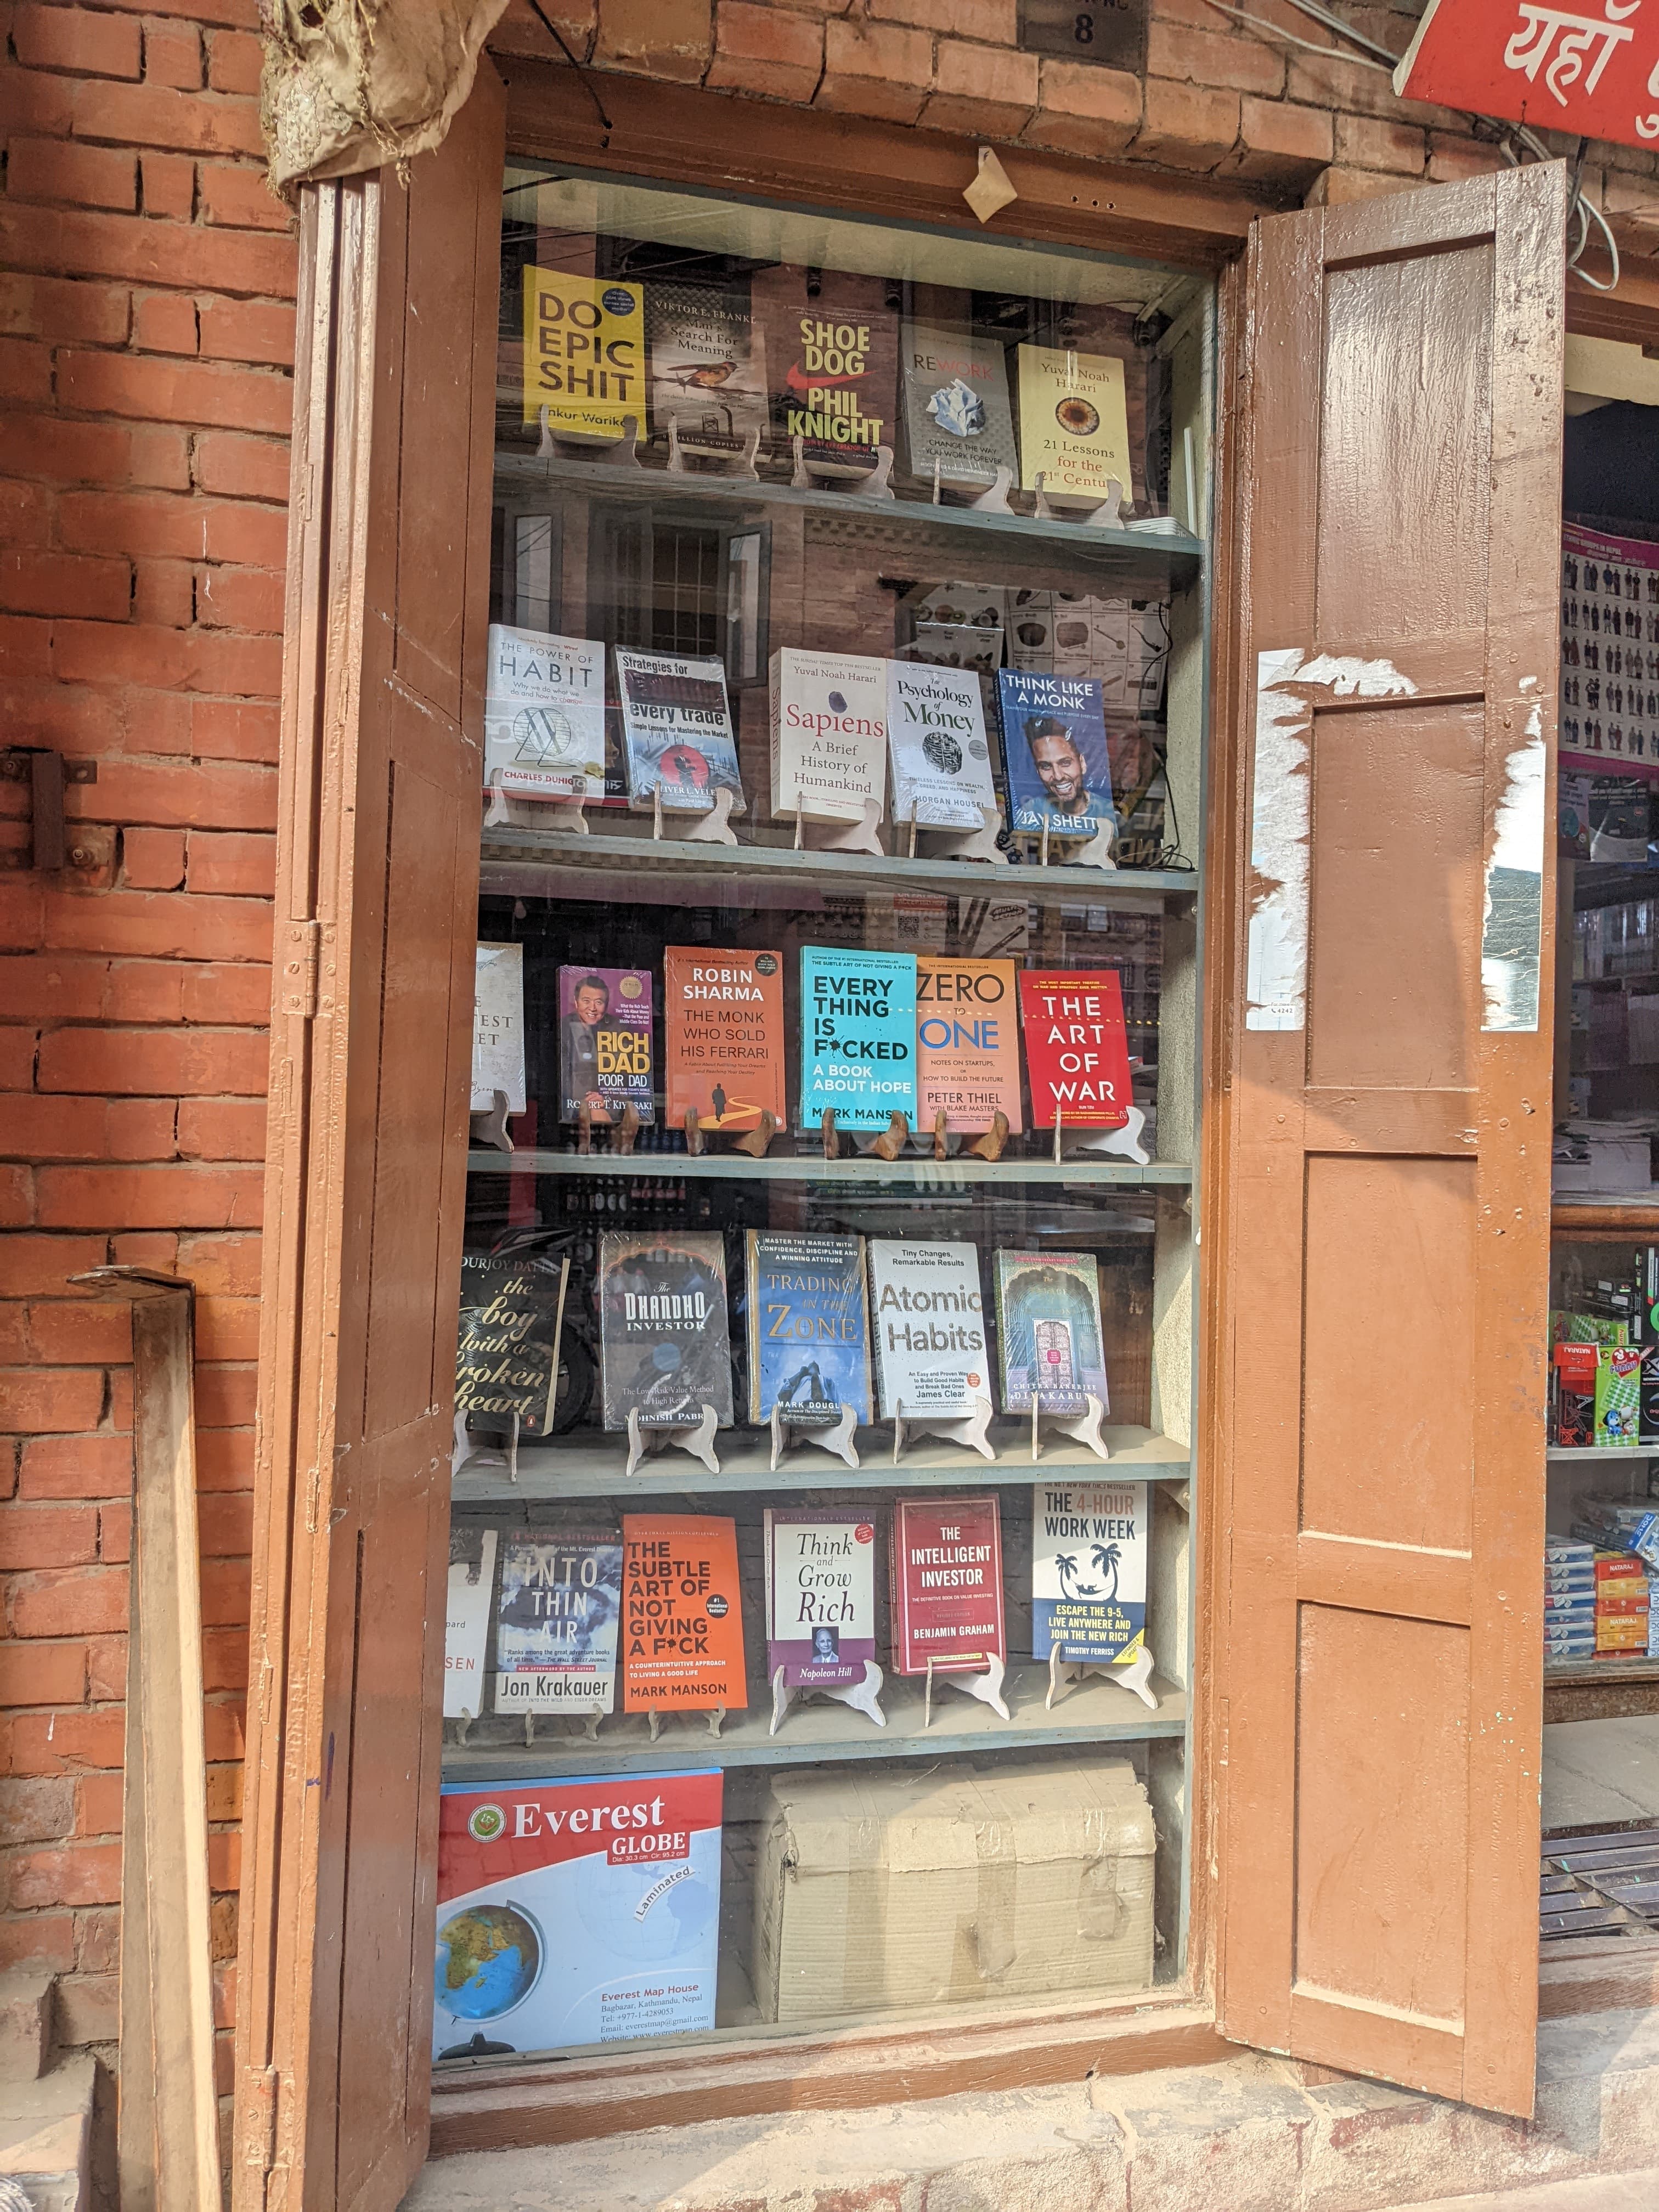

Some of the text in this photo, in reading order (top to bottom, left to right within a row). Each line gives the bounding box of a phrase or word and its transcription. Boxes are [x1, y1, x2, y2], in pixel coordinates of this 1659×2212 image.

[1075, 14, 1093, 44] 8
[539, 291, 602, 329] DO
[670, 326, 738, 346] Search For
[800, 319, 870, 351] SHOE
[539, 326, 635, 368] EPIC
[678, 339, 733, 359] Meaning
[806, 346, 865, 375] DOG
[913, 354, 995, 381] REWORK
[538, 360, 634, 402] SHIT
[808, 387, 862, 417] PHIL
[788, 410, 883, 445] KNIGHT
[1043, 439, 1115, 459] 21 Lessons
[1058, 456, 1102, 472] for the
[501, 642, 522, 653] THE
[530, 647, 571, 662] POWER
[578, 655, 593, 663] OF
[500, 655, 592, 688] HABIT
[623, 656, 688, 675] Strategies for
[794, 666, 877, 683] Yuval Noah Harari
[896, 680, 973, 708] Psychology
[1006, 675, 1093, 697] THINK LIKE
[1018, 691, 1085, 710] A MONK
[630, 703, 724, 726] every trade
[787, 704, 883, 737] Sapiens
[902, 701, 975, 737] Money
[812, 741, 859, 756] A Brief
[801, 755, 867, 774] History of
[794, 772, 872, 793] Humankind
[693, 968, 753, 984] ROBIN
[684, 985, 764, 1002] SHARMA
[814, 976, 893, 997] EVERY
[916, 973, 1005, 1003] ZERO
[814, 997, 890, 1017] THING
[1042, 997, 1101, 1016] THE
[684, 1010, 764, 1024] THE MONK
[815, 1018, 835, 1036] IS
[597, 1031, 649, 1053] RICH
[684, 1028, 765, 1041] WHO SOLD
[919, 1019, 999, 1049] ONE
[1048, 1025, 1104, 1045] ART
[681, 1046, 769, 1059] HIS FERRARI
[598, 1052, 650, 1074] DAD
[813, 1064, 872, 1077] A BOOK
[1059, 1053, 1099, 1073] OF
[598, 1074, 647, 1087] POOR DAD
[813, 1081, 911, 1093] ABOUT HOPE
[928, 1093, 1001, 1103] PETER THIEL
[1049, 1081, 1115, 1102] WAR
[902, 1249, 952, 1259] Tiny Changes,
[503, 1277, 533, 1295] the
[767, 1274, 853, 1293] TRADING
[624, 1291, 706, 1321] DHANDHO
[879, 1284, 981, 1312] Atomic
[482, 1296, 538, 1341] boy
[627, 1321, 706, 1331] INVESTOR
[768, 1304, 856, 1340] ZONE
[888, 1323, 983, 1352] Habits
[1609, 1361, 1637, 1374] Funny
[1045, 1492, 1134, 1515] THE 4-HOUR
[940, 1527, 961, 1541] THE
[1045, 1517, 1136, 1540] WORK WEEK
[628, 1542, 670, 1558] THE
[797, 1533, 853, 1555] Think
[816, 1556, 832, 1566] and
[911, 1545, 991, 1565] INTELLIGENT
[524, 1557, 597, 1587] INTO
[628, 1561, 710, 1578] SUBTLE
[798, 1565, 852, 1587] Grow
[922, 1570, 983, 1588] INVESTOR
[629, 1579, 709, 1598] ART OF
[532, 1592, 587, 1616] THIN
[629, 1599, 676, 1617] NOT
[796, 1592, 854, 1622] Rich
[1057, 1605, 1123, 1618] ESCAPE THE 9-5,
[541, 1621, 577, 1644] AIR
[629, 1617, 708, 1637] GIVING
[913, 1624, 994, 1639] BENJAMIN GRAHAM
[1049, 1617, 1130, 1629] LIVE ANYWHERE AND
[1051, 1629, 1128, 1641] JOIN THE NEW RICH
[629, 1639, 646, 1657] A
[1065, 1646, 1114, 1655] TIMOTHY FERRISS
[800, 1667, 852, 1680] Napoleon Hill
[501, 1674, 608, 1696] Jon Krakauer
[630, 1684, 727, 1698] MARK MANSON
[512, 1795, 665, 1838] Everest
[612, 1832, 685, 1855] GLOBE
[636, 1866, 690, 1917] Laminated
[602, 1984, 699, 2001] Everest Map House
[602, 1994, 702, 2013] Bagbazar, Kathmandu, Nepal
[625, 2015, 708, 2030] everestmap@gmail.com
